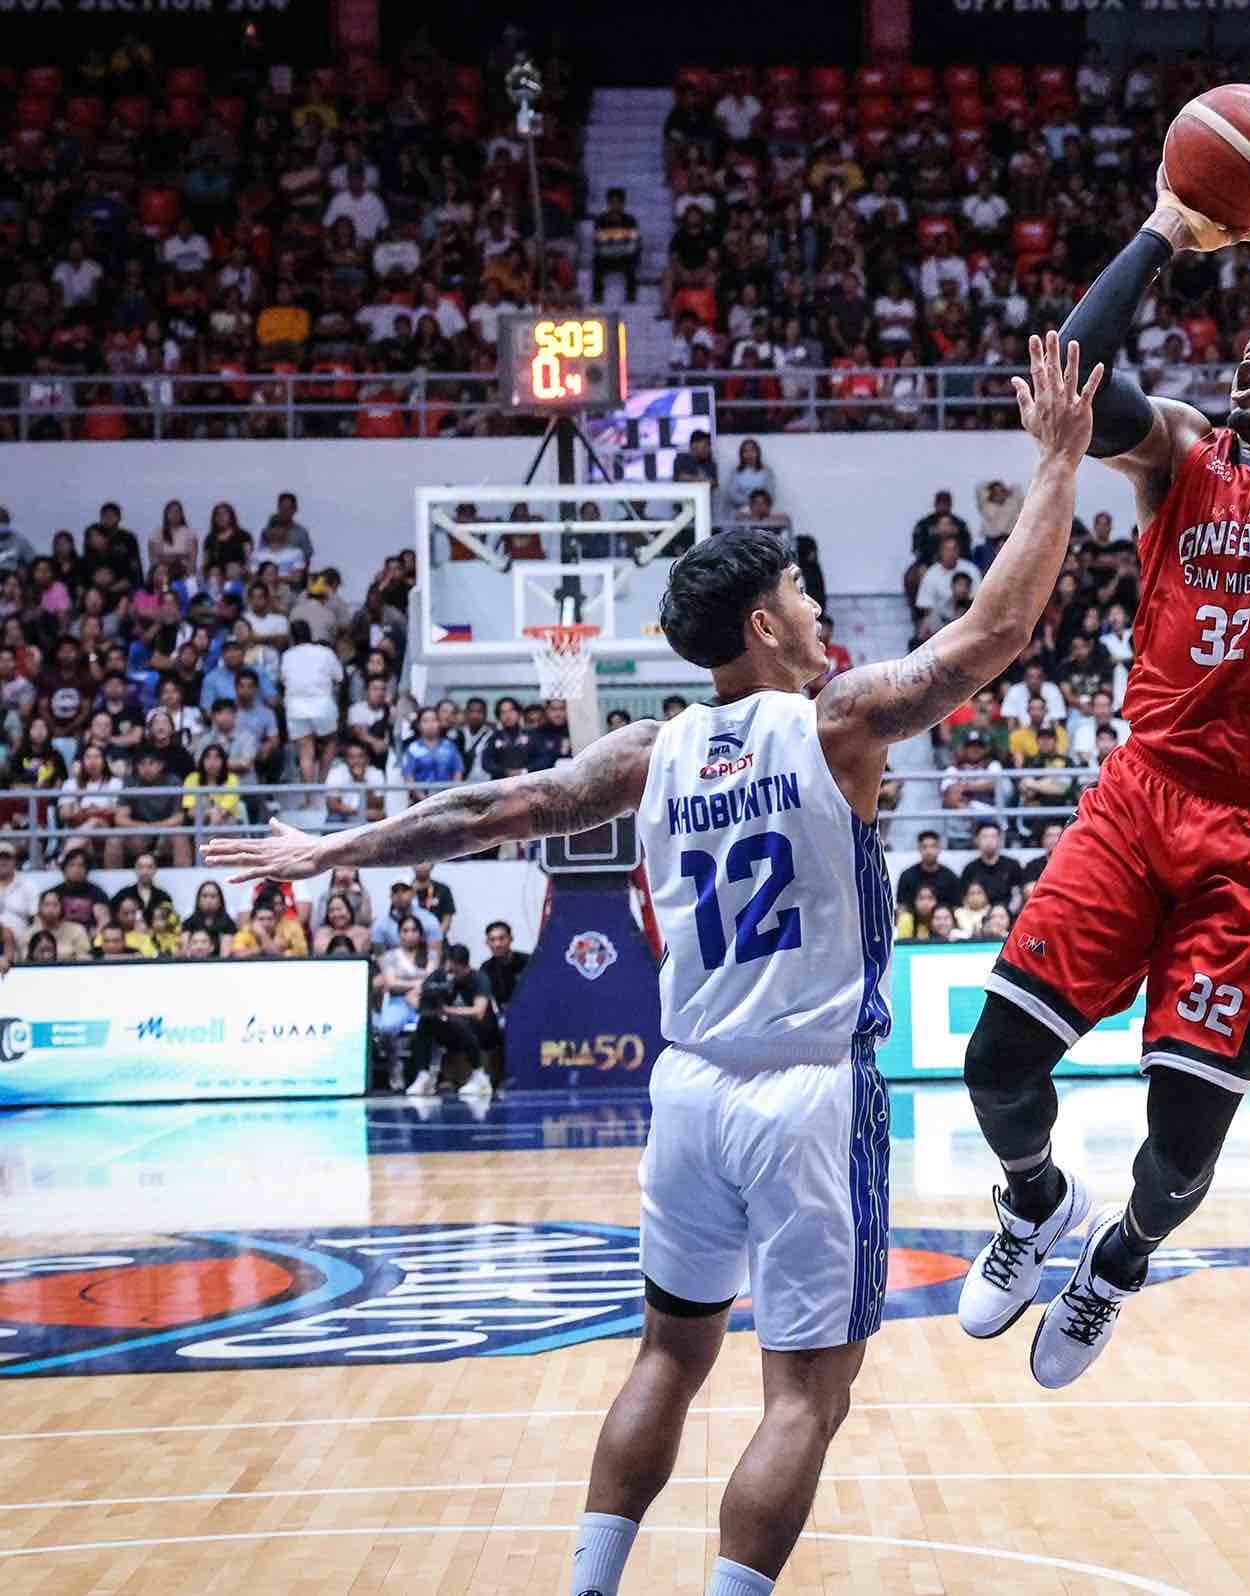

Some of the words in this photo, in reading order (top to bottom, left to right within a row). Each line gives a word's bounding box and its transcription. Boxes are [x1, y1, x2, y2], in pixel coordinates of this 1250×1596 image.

[1183, 563, 1219, 591] SAN
[667, 772, 802, 836] KHOBUNTIN
[680, 831, 802, 971] 12
[1176, 972, 1244, 1038] 32
